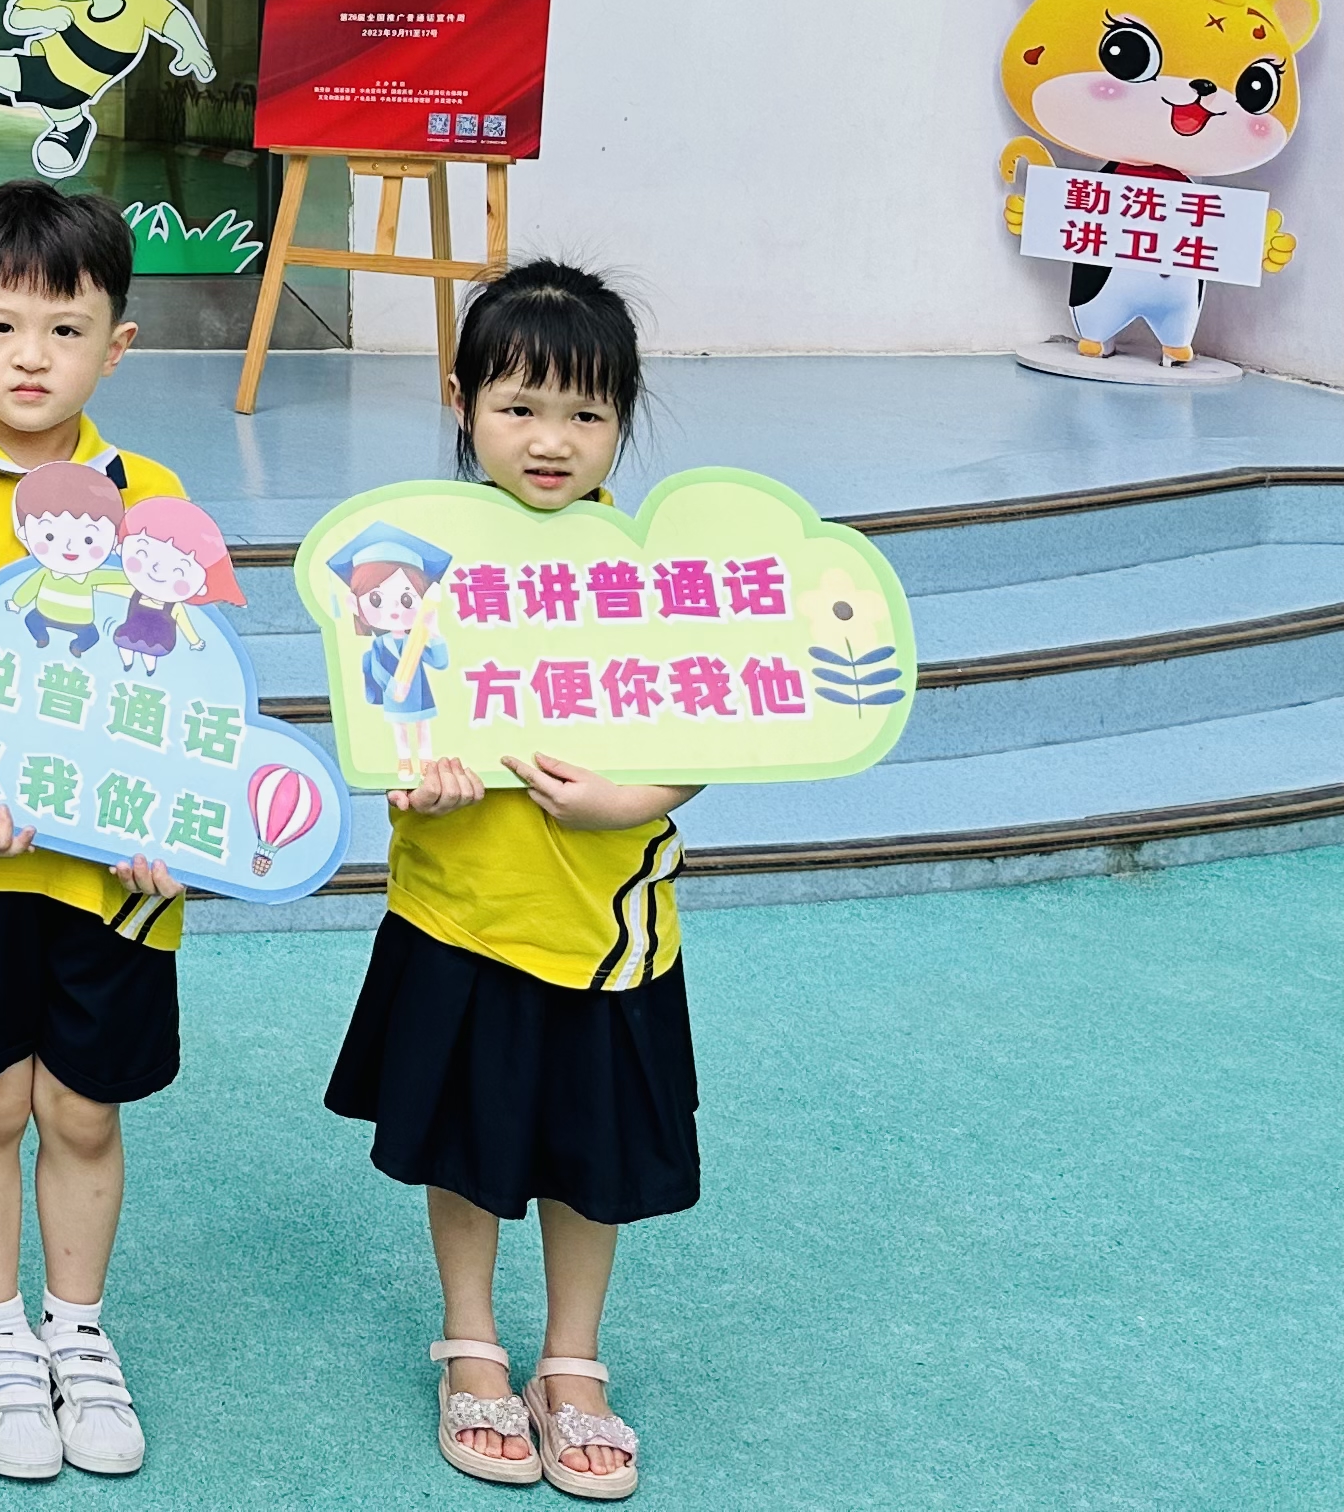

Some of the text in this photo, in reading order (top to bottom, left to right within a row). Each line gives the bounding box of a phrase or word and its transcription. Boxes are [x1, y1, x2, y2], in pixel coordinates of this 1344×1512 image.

[1064, 177, 1226, 228] 勤洗手
[1059, 220, 1220, 274] 讲卫生
[448, 556, 789, 624] 请讲普通话
[464, 655, 808, 721] 方便你我他
